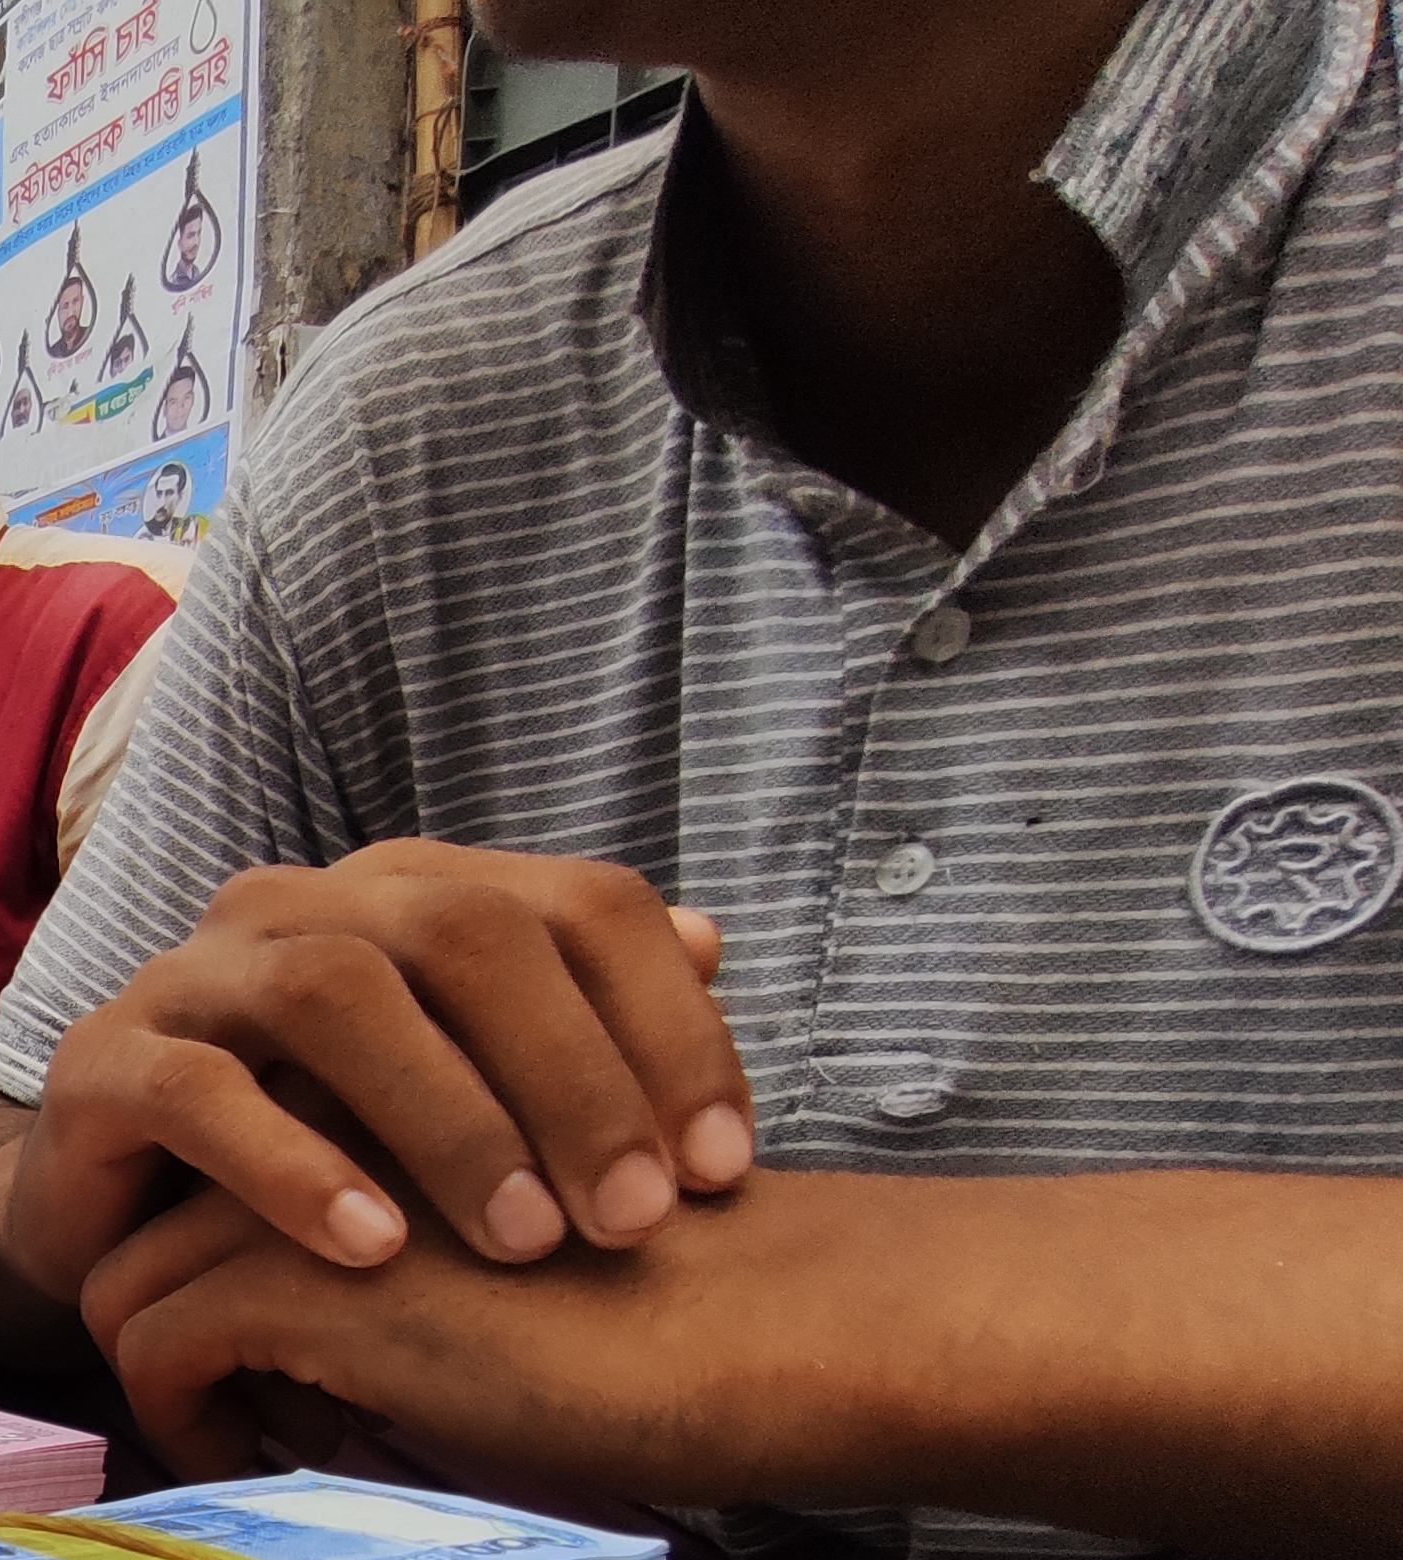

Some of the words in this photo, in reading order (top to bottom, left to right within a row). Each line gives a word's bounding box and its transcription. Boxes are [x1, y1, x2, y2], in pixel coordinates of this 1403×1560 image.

[46, 26, 107, 100] ফাঁসি
[115, 0, 158, 62] চাই
[8, 115, 124, 225] দৃষ্টান্তমূলক
[131, 66, 181, 133] শাস্তি
[189, 37, 230, 102] চাই
